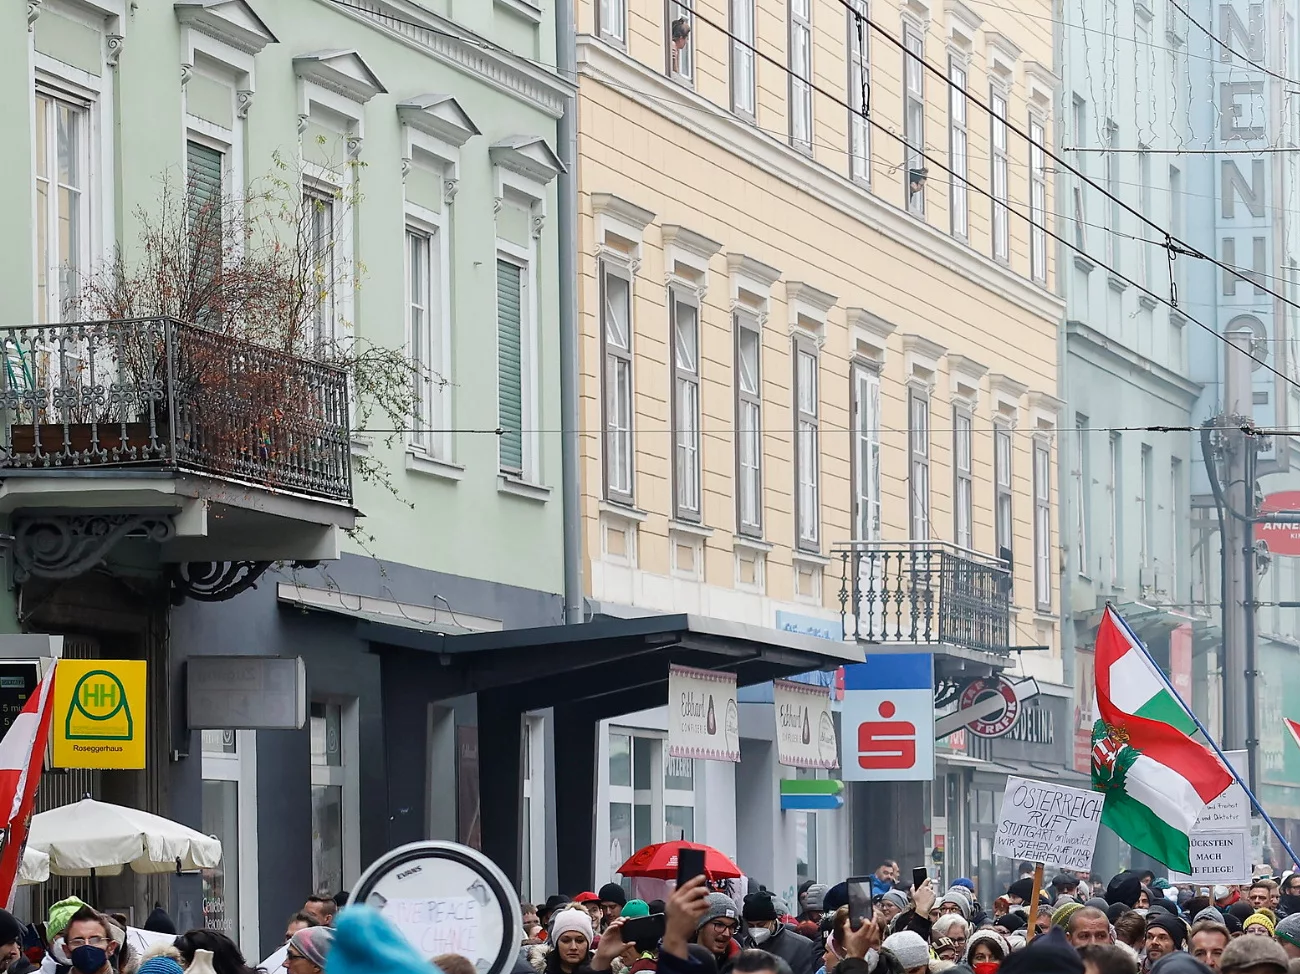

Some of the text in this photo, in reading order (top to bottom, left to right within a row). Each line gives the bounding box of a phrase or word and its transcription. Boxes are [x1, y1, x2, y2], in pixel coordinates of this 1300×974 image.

[681, 692, 707, 718] Eckhard
[976, 701, 1016, 734] TRAFIK
[73, 744, 123, 753] Roseggerhaus
[1000, 819, 1055, 842] STUTTGART
[1028, 810, 1077, 833] RUFT
[1017, 839, 1053, 852] STEHEN
[1053, 845, 1073, 855] AUF
[1073, 847, 1091, 857] UND
[1190, 838, 1234, 847] ÜCKSTEIN
[1013, 848, 1061, 864] WEHREN
[1202, 866, 1234, 874] FLIEGE!
[427, 901, 476, 923] PEACE
[421, 925, 478, 953] CHANCE
